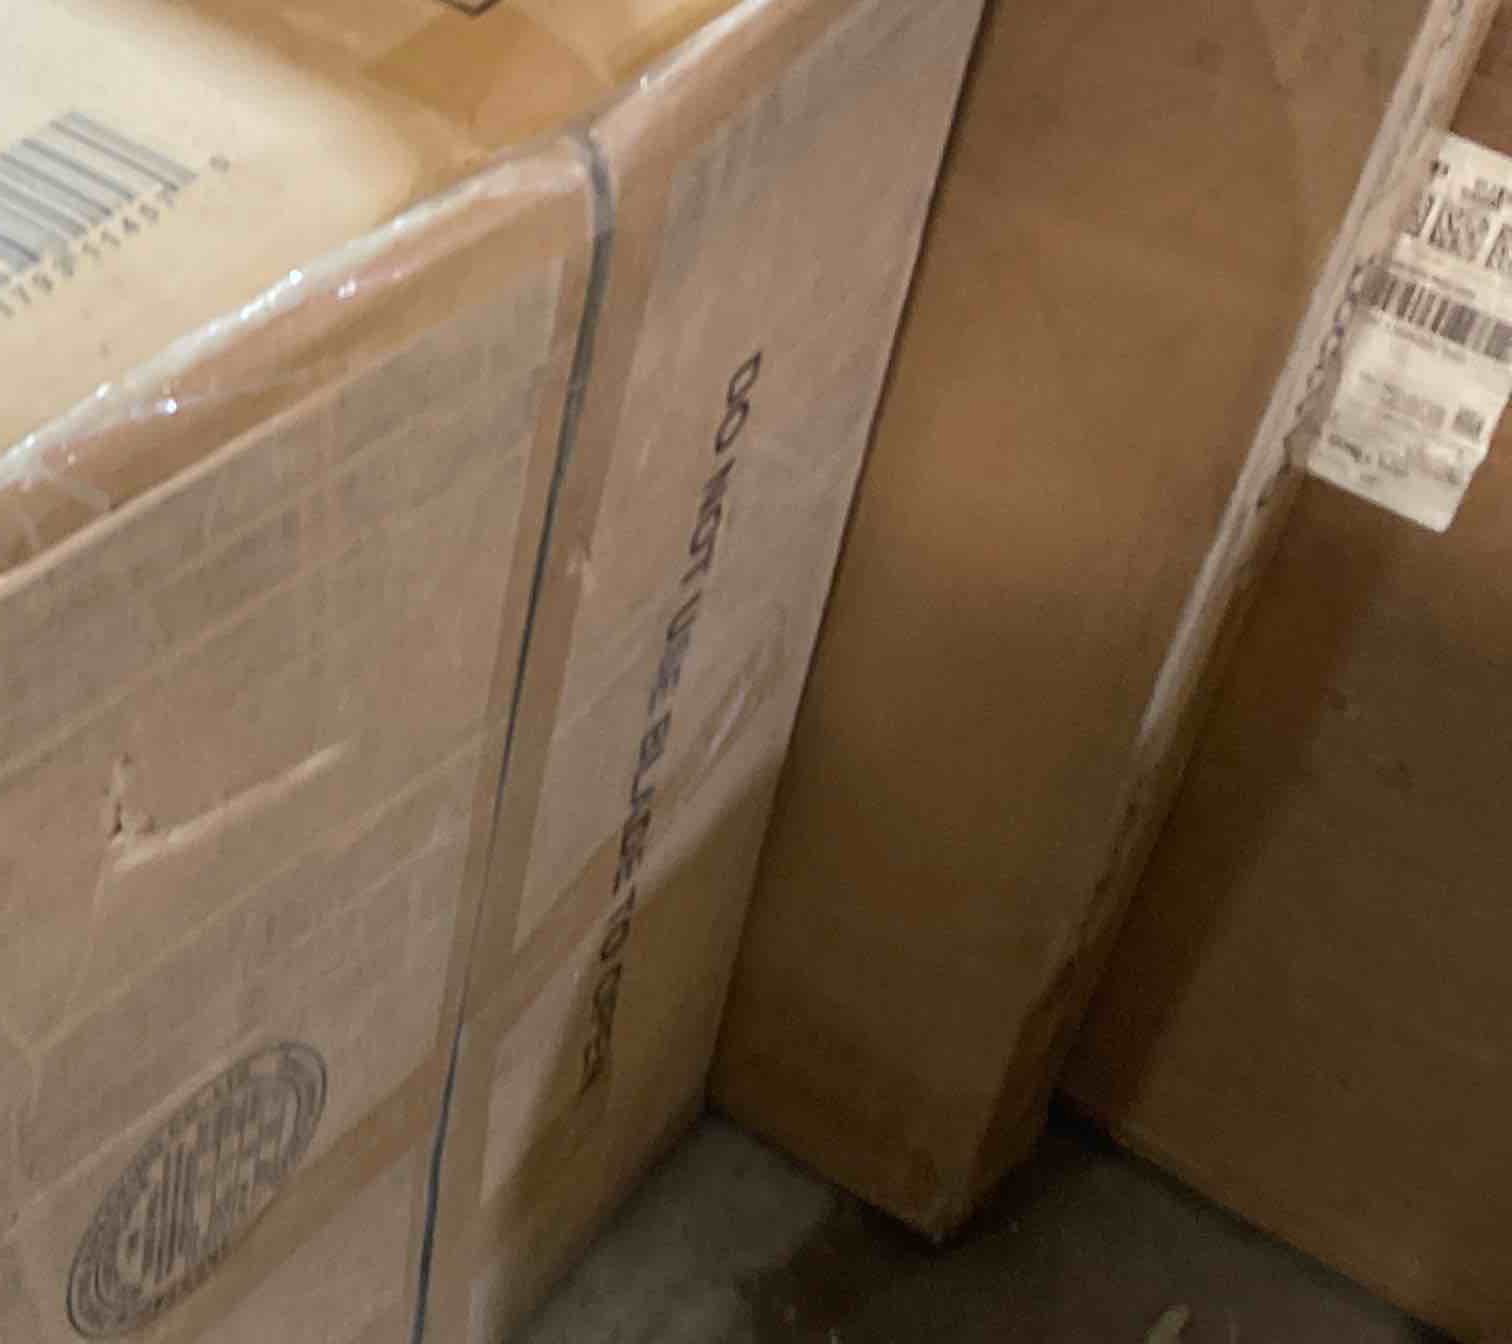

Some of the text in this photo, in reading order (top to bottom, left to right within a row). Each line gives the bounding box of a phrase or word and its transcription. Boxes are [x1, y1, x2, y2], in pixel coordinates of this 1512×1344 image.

[713, 350, 764, 454] DO
[679, 456, 737, 584] NOT
[611, 710, 673, 896] BLADE
[599, 888, 637, 962] TO
